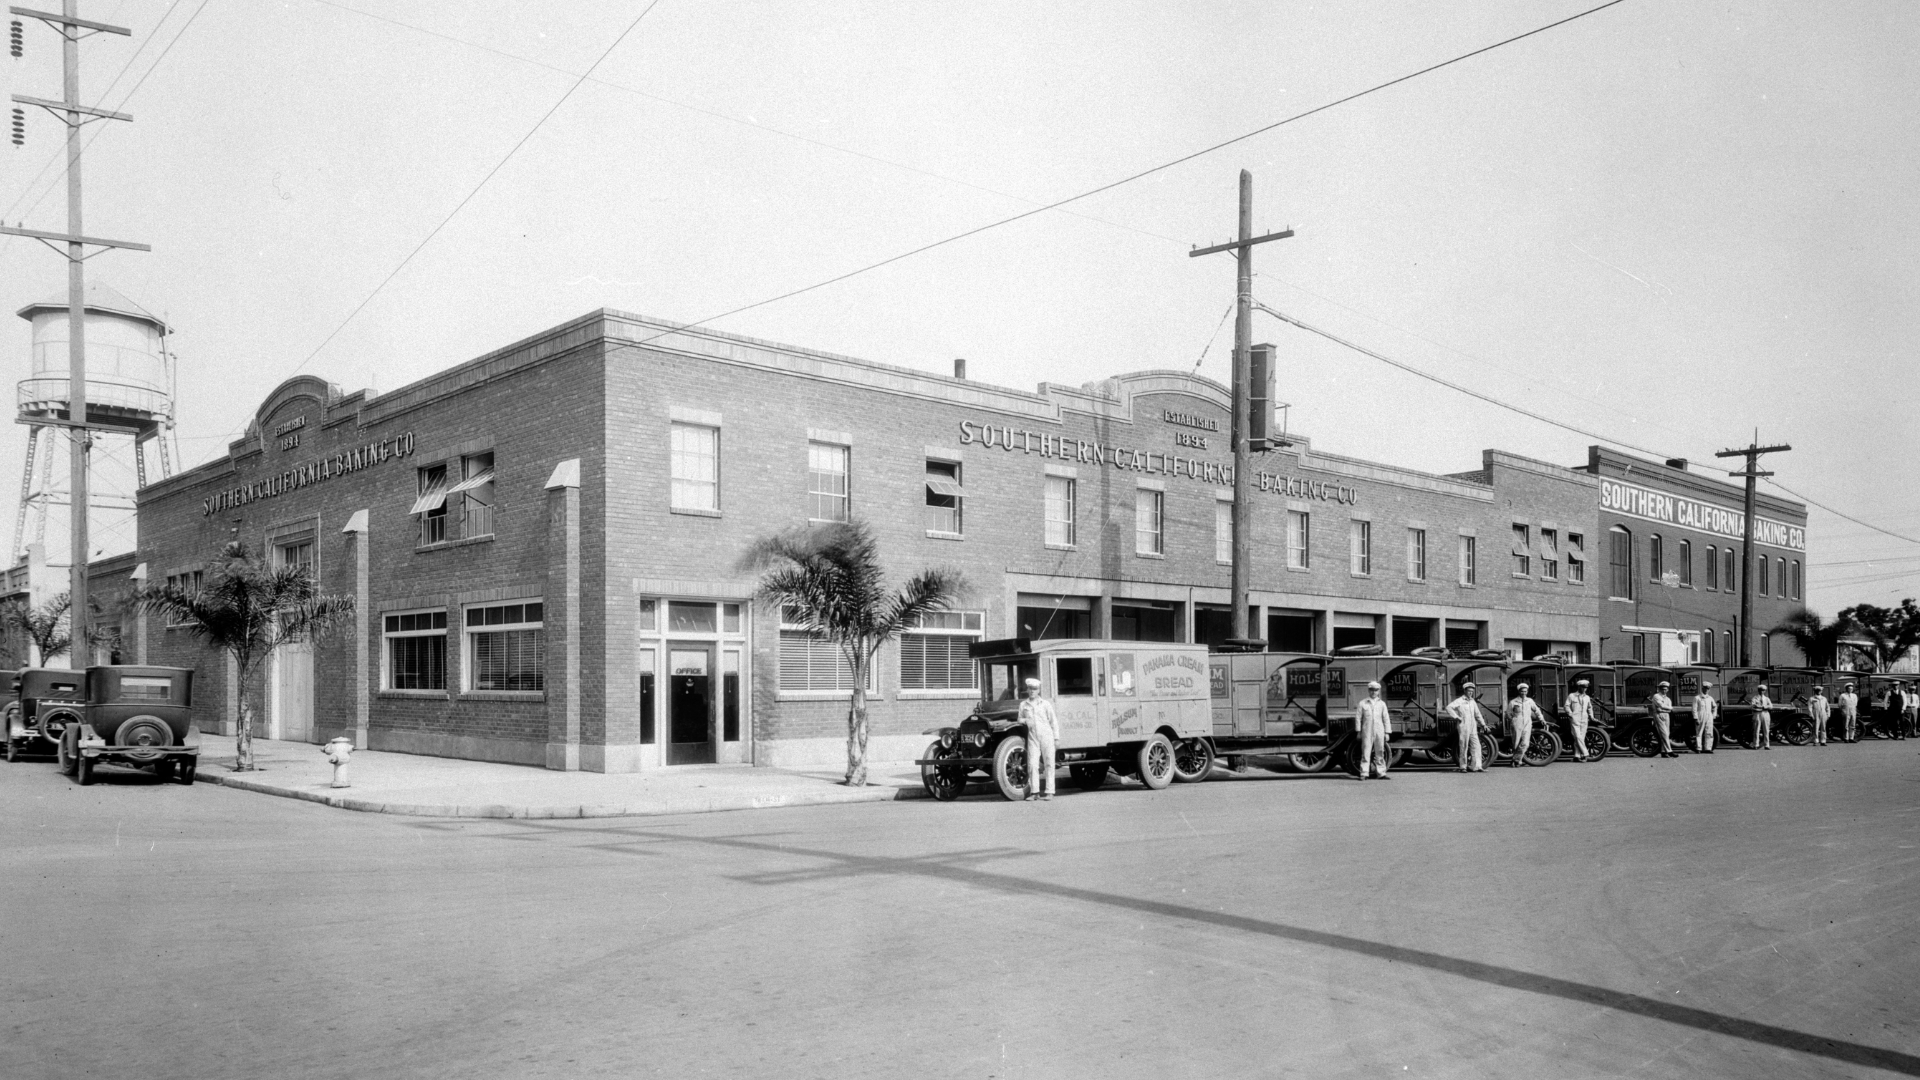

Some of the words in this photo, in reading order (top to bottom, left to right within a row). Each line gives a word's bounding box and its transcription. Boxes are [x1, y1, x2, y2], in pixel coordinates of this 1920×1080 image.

[1164, 410, 1219, 431] ESTABLISHED
[281, 434, 299, 451] 1894
[1176, 432, 1207, 450] 1894
[960, 419, 1104, 465] SOUTHERN
[1114, 447, 1235, 486] CALIFORNI
[1260, 471, 1329, 501] BAKING
[1338, 485, 1357, 505] CO
[203, 481, 254, 515] SOUTHERN
[258, 459, 330, 498] CALIFORNIA
[336, 439, 389, 476] BAKING
[395, 431, 414, 458] CO
[1602, 482, 1673, 522] SOUTHERN
[1678, 500, 1745, 537] CALIFORNIA
[1790, 528, 1805, 549] CO.
[675, 667, 702, 675] OFFICE
[1143, 654, 1175, 675] PANAMA
[1178, 655, 1204, 675] CREAM
[1155, 677, 1193, 689] BREAD
[1112, 708, 1138, 730] HOLSUM
[1118, 727, 1138, 738] PRODUCT
